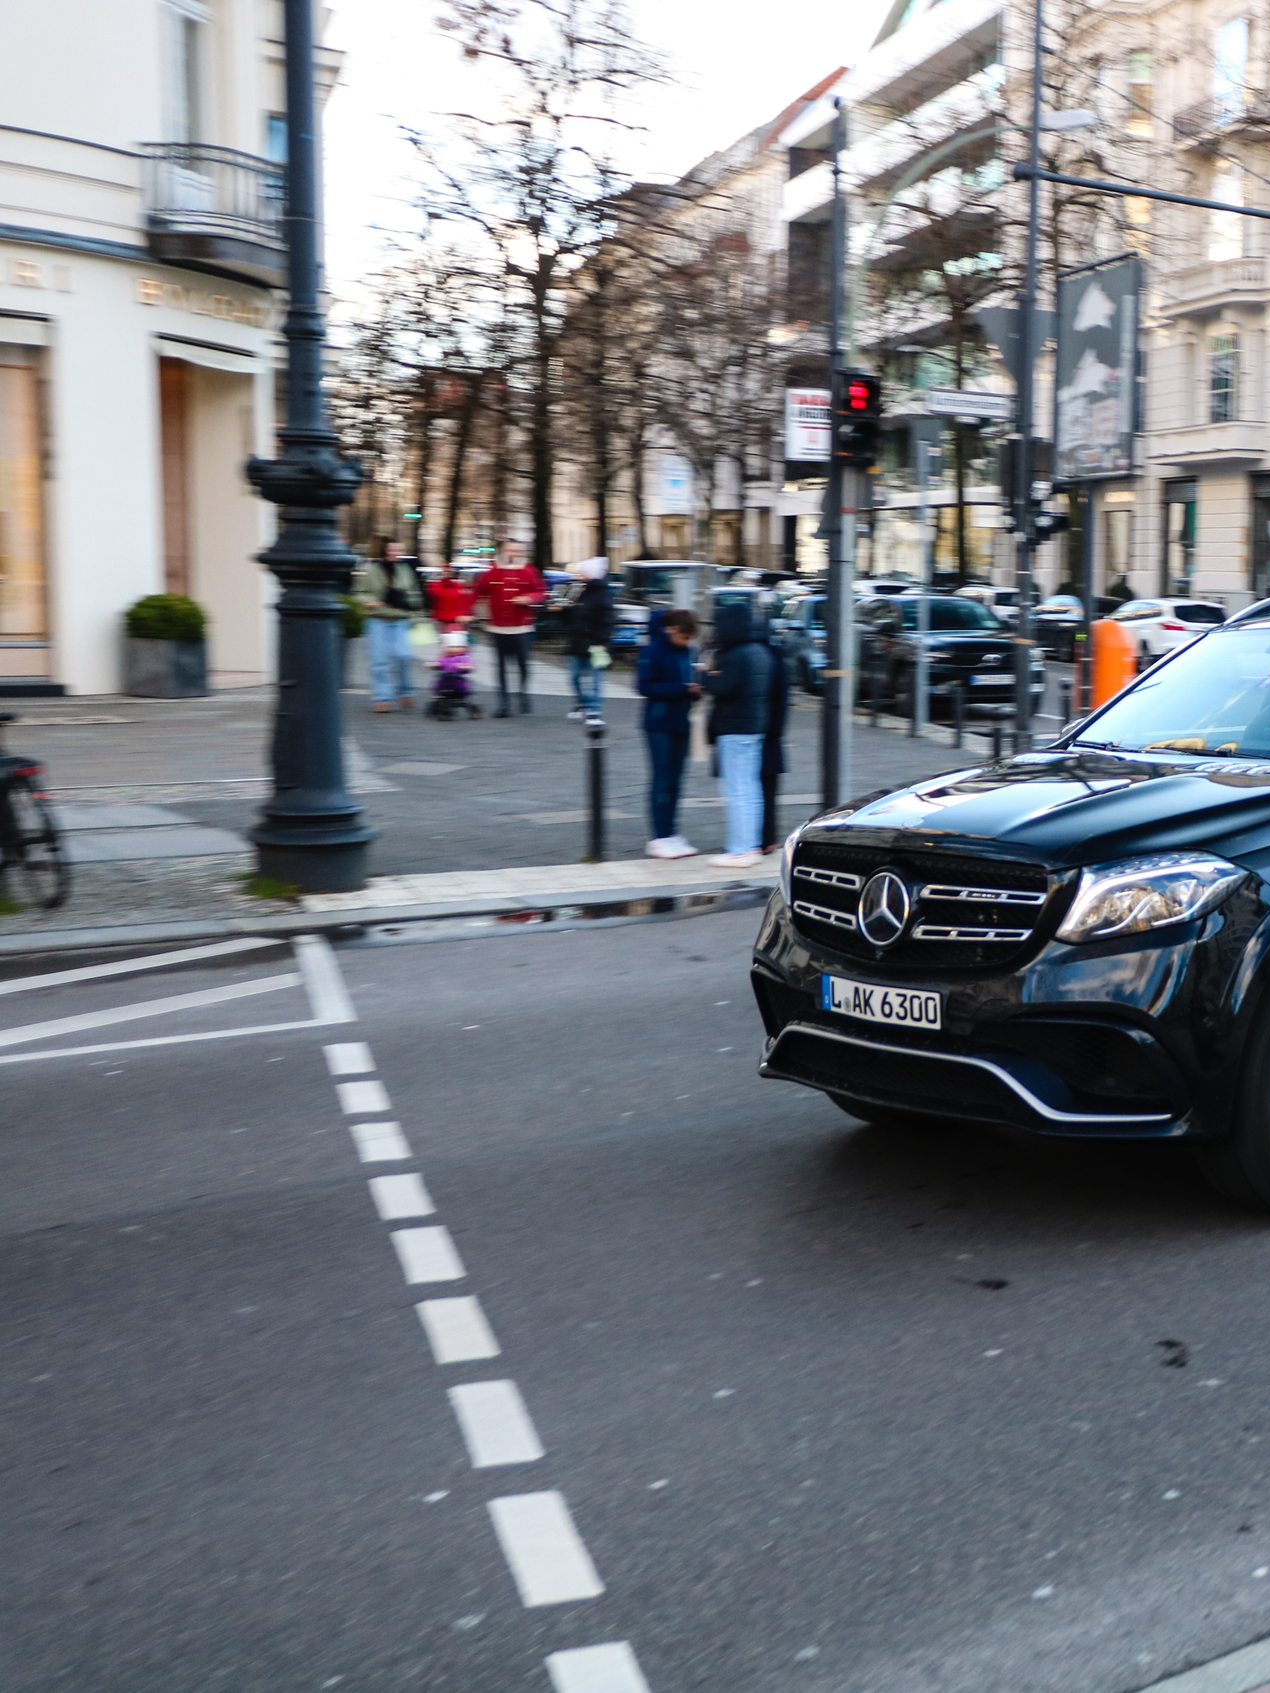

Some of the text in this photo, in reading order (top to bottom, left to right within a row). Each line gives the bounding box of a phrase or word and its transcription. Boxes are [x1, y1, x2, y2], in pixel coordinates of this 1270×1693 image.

[831, 980, 938, 1024] L AK 6300
